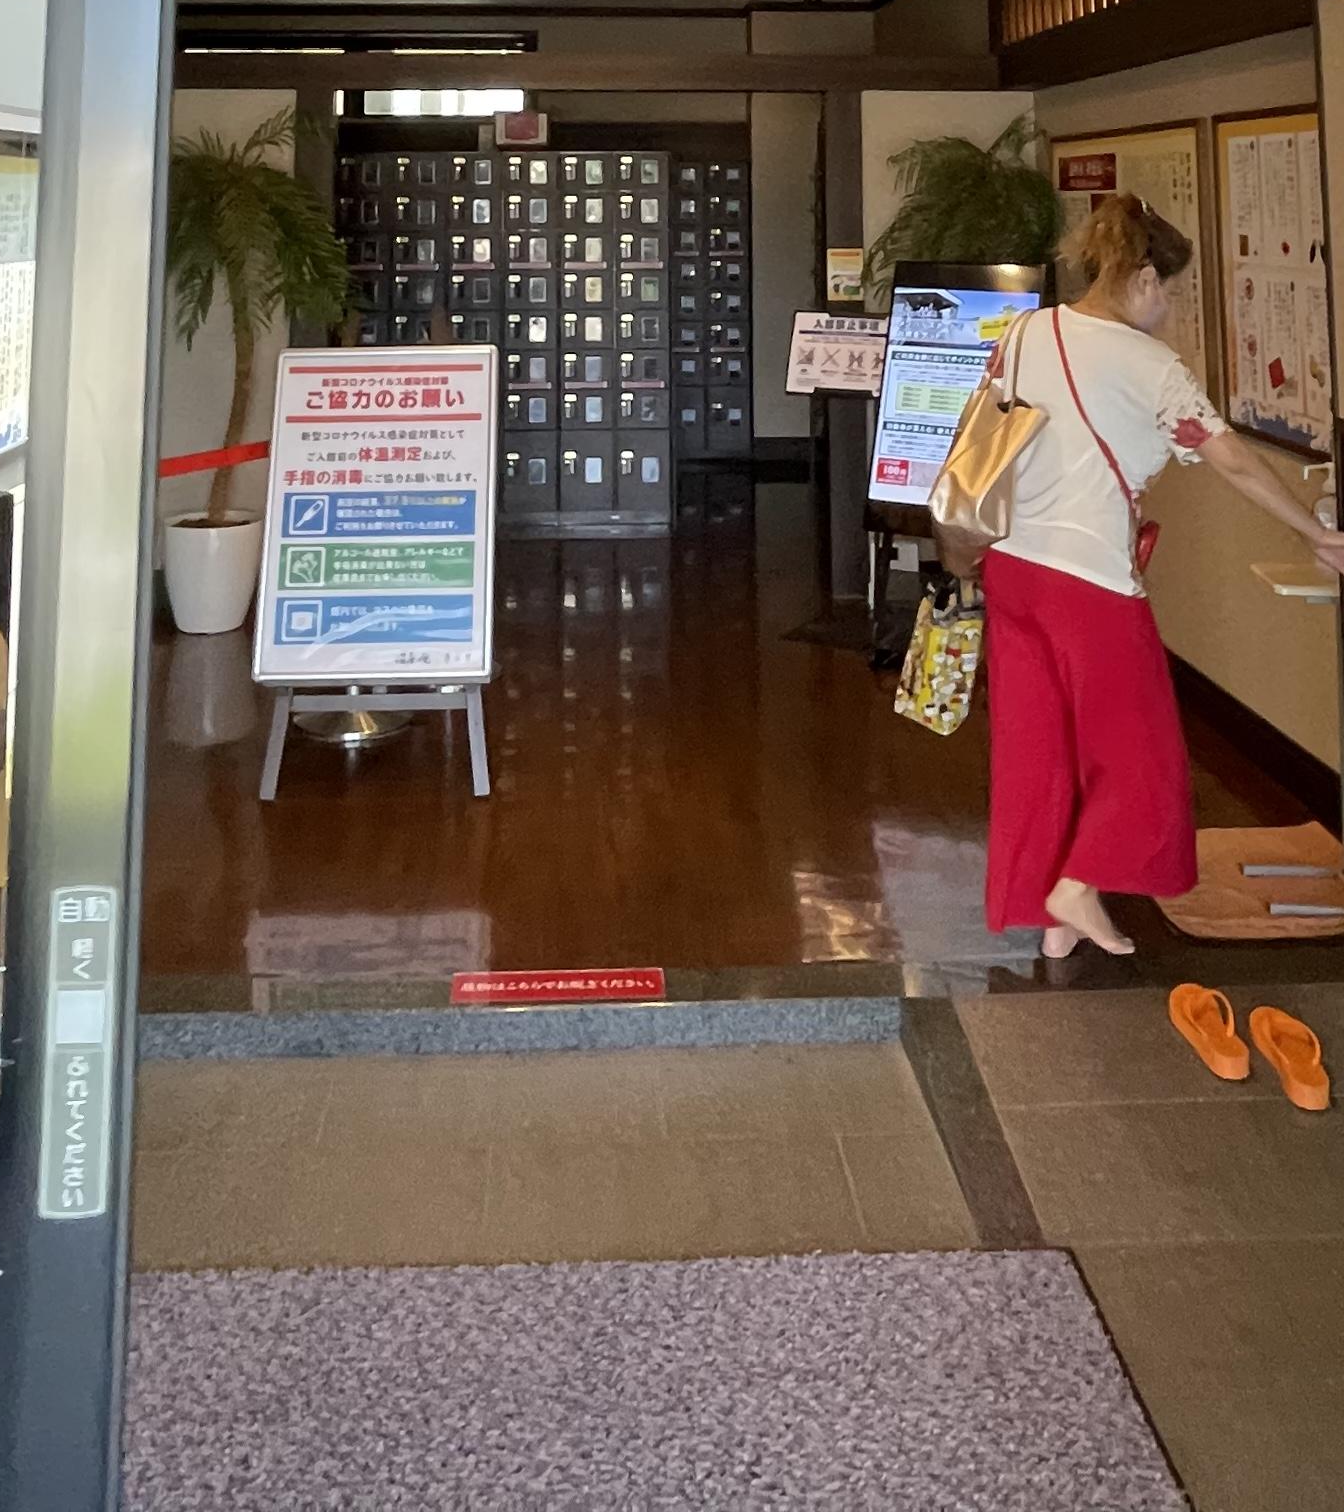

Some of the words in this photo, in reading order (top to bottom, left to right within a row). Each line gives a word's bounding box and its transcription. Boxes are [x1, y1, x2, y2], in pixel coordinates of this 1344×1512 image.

[306, 389, 465, 410] ご協力のお願い
[57, 895, 111, 923] 自動
[61, 1055, 90, 1208] ふれてください
